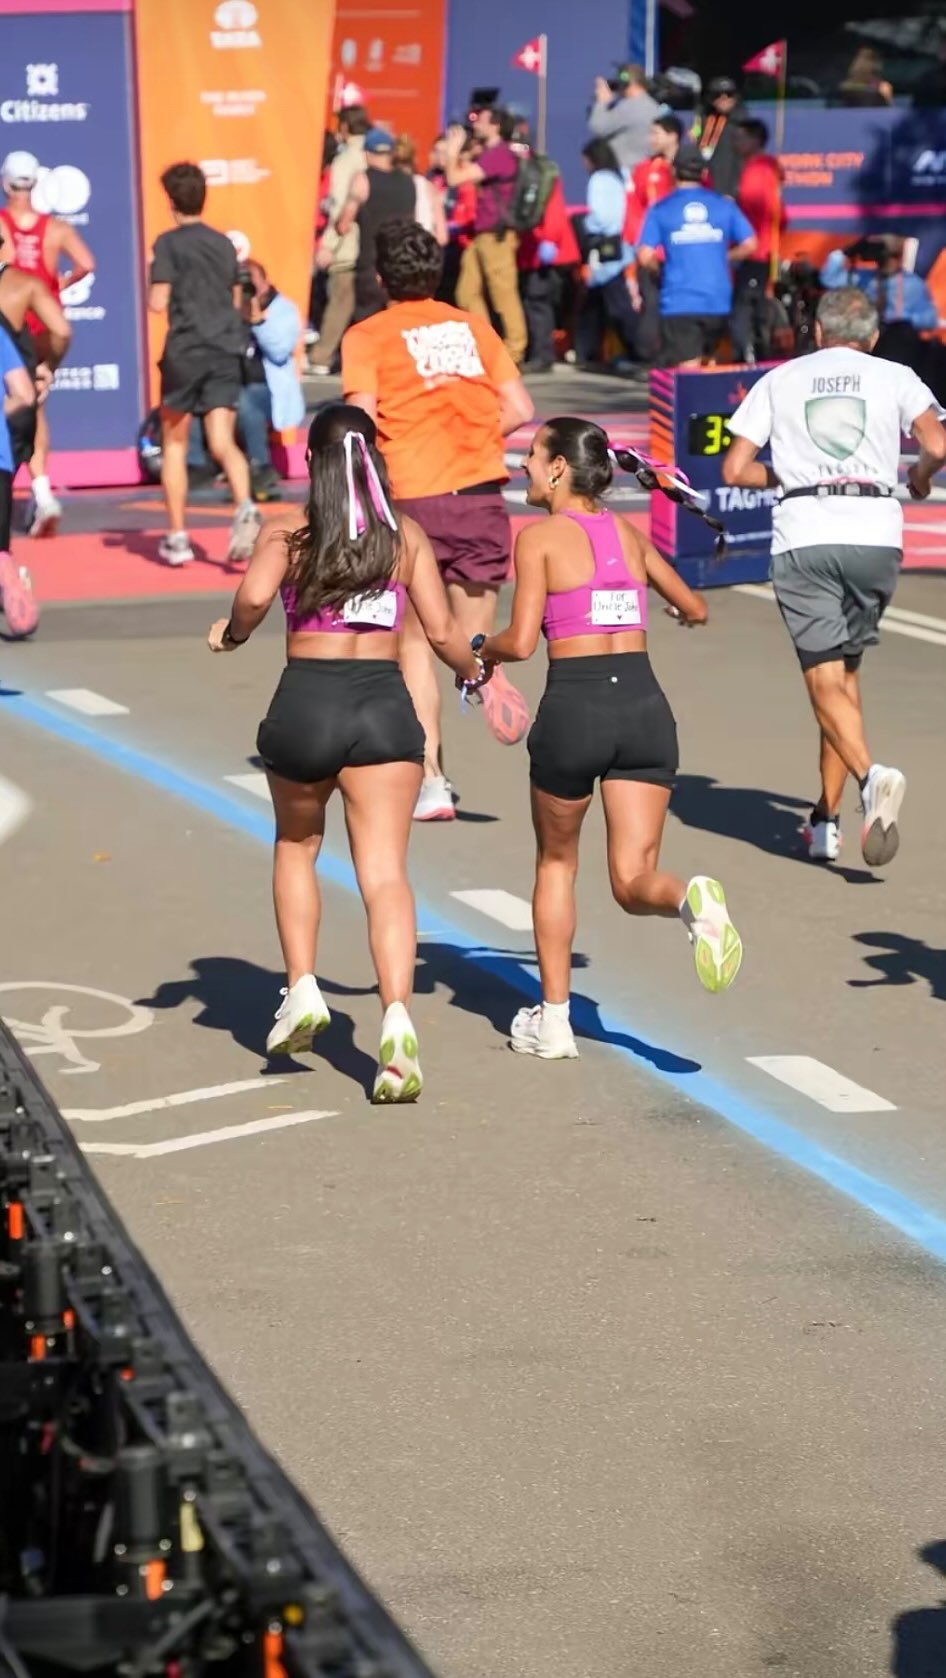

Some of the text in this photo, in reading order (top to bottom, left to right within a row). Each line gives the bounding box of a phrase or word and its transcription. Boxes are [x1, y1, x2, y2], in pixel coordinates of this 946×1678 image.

[0, 100, 87, 122] Citizens
[811, 376, 862, 394] JOSEPH
[610, 592, 626, 602] For
